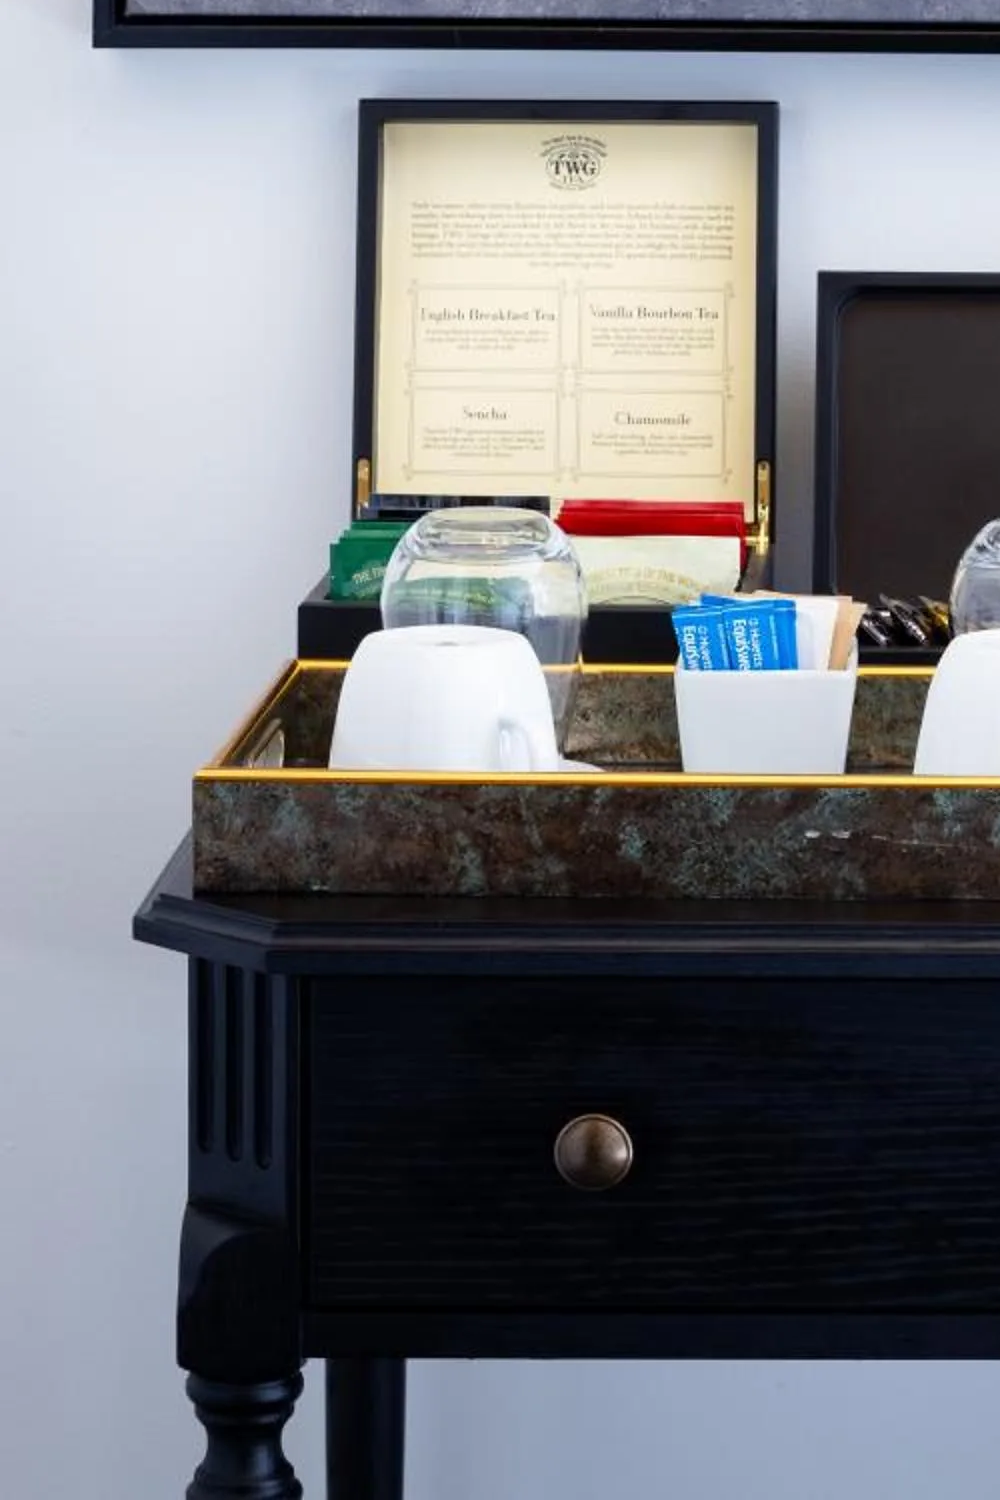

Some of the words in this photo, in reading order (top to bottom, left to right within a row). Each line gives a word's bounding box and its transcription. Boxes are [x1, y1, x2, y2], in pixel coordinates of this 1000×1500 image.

[548, 160, 597, 176] TWG
[420, 307, 466, 324] English
[468, 307, 529, 321] Breakfast
[532, 307, 556, 321] Tea
[590, 304, 634, 318] Vanilla
[637, 306, 694, 320] Bourbon
[695, 306, 719, 320] Tea
[462, 405, 508, 420] Sencha
[614, 410, 691, 426] Chamomile
